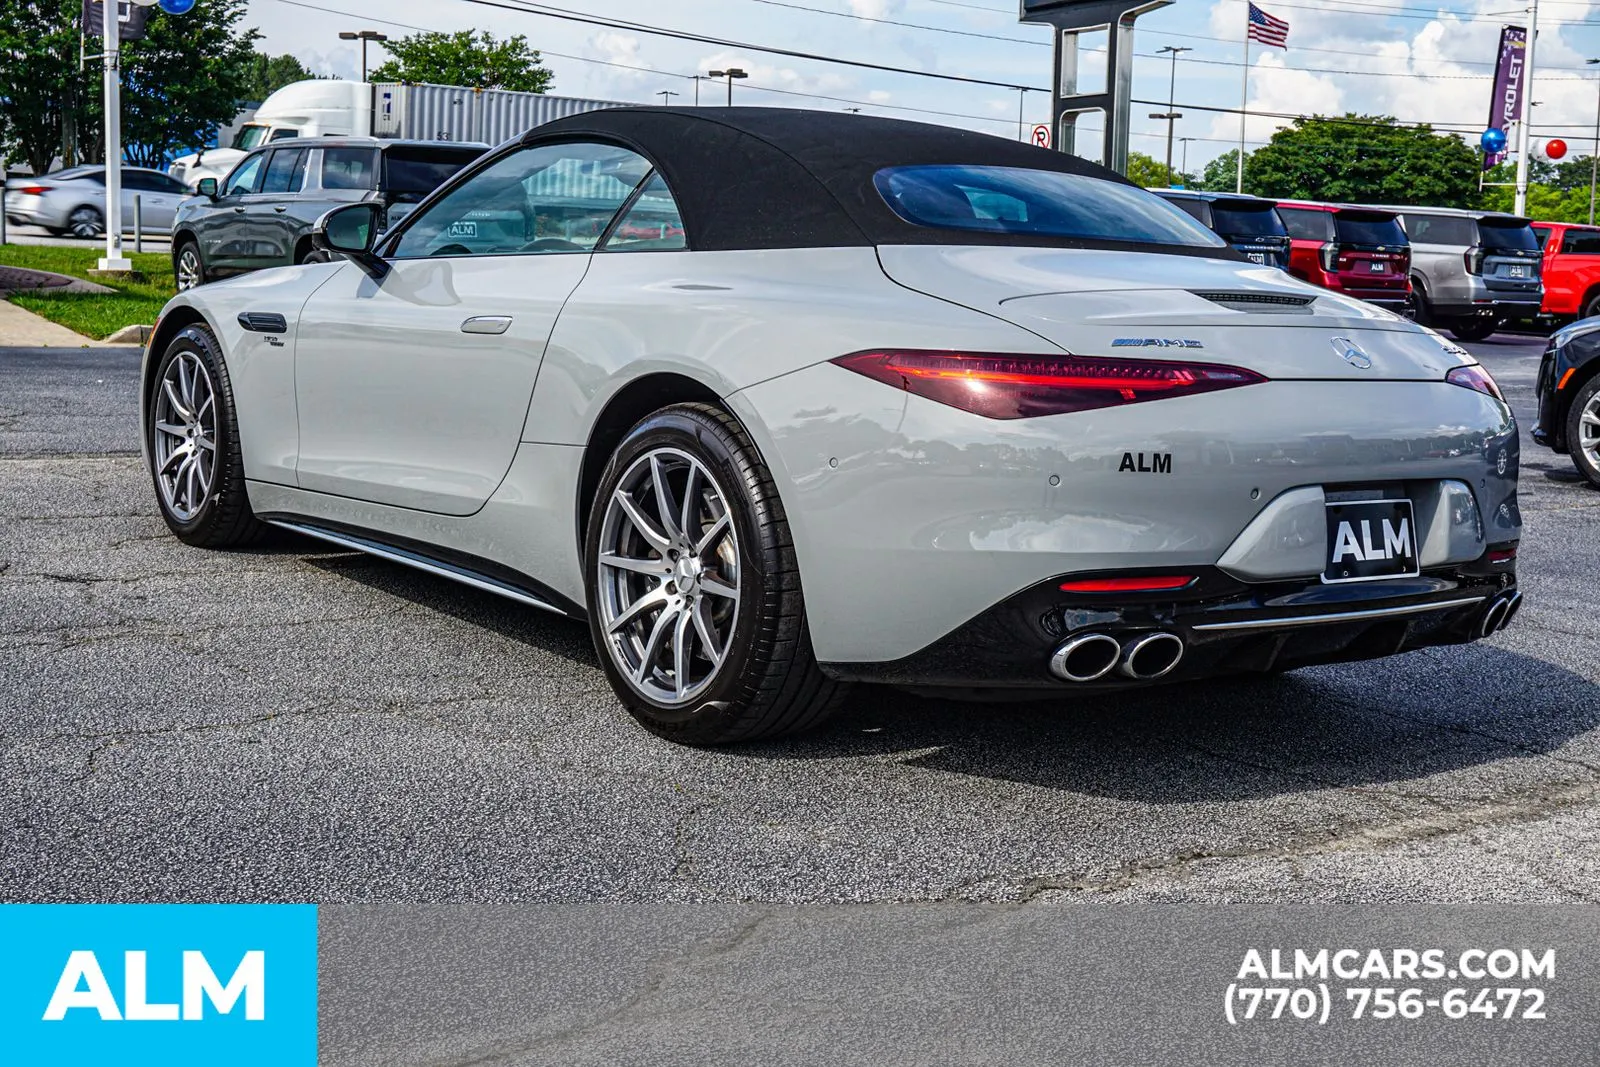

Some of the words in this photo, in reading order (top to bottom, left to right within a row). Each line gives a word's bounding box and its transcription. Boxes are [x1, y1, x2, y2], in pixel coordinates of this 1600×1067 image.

[451, 225, 474, 235] ALM
[1371, 263, 1384, 271] ALM
[1118, 452, 1172, 473] ALM
[1332, 517, 1412, 563] ALM
